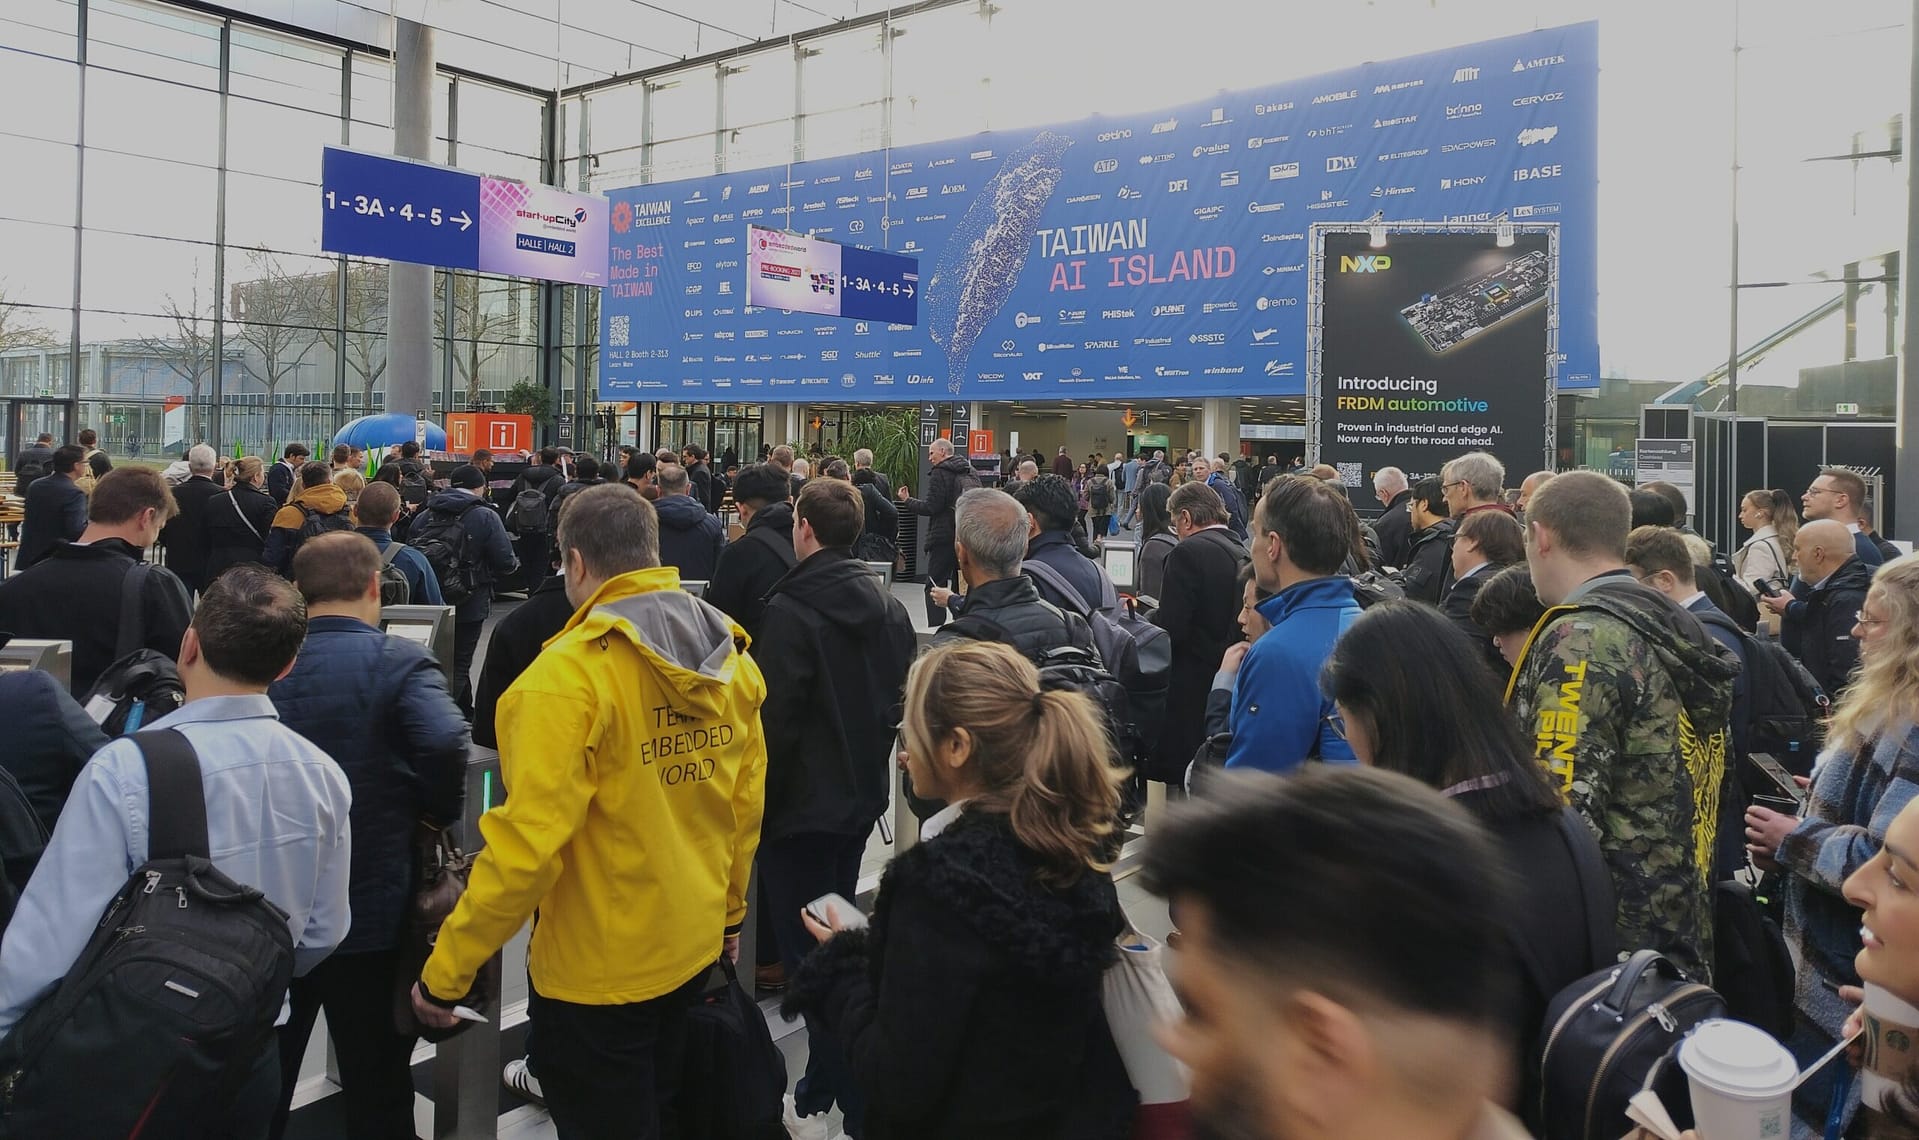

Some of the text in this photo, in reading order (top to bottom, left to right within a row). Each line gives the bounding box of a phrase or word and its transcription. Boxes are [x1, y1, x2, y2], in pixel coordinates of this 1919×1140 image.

[1525, 54, 1565, 69] AMTEK
[1312, 90, 1359, 104] AMOBILE
[1512, 92, 1564, 107] CERVOZ
[1266, 102, 1294, 113] akasa
[1382, 115, 1417, 127] BIOSTAR
[1441, 138, 1496, 153] EDACPOWER
[1390, 149, 1430, 160] ELITEGROUP
[1514, 164, 1562, 182] iBASE
[1168, 179, 1188, 192] DFI
[1454, 176, 1487, 186] HONY
[1385, 186, 1416, 196] Himax
[634, 200, 671, 216] TAIWAN
[1194, 206, 1224, 215] GIGAIPC
[516, 210, 576, 228] start-upCity
[636, 216, 672, 227] EXCELLENCE
[1444, 212, 1491, 224] Lanner
[1036, 218, 1147, 258] TAIWAN
[518, 238, 574, 254] HALLE HALL 2
[611, 244, 664, 260] The Best
[1050, 246, 1236, 292] AI ISLAND
[1340, 256, 1391, 273] NXP
[610, 264, 658, 280] Made in
[610, 282, 653, 298] TAIWAN
[1161, 304, 1185, 314] PLANET
[1084, 340, 1120, 349] SPARKLE
[1198, 333, 1225, 342] SSSTC
[631, 350, 649, 358] Booth
[855, 351, 882, 359] Shuttle
[1338, 376, 1438, 395] Introducing
[1337, 397, 1488, 412] FRDM automotive
[1140, 410, 1148, 426] 1
[1337, 423, 1503, 436] Proven in industrial and edge AI.
[1337, 435, 1494, 446] Now ready for the road ahead.
